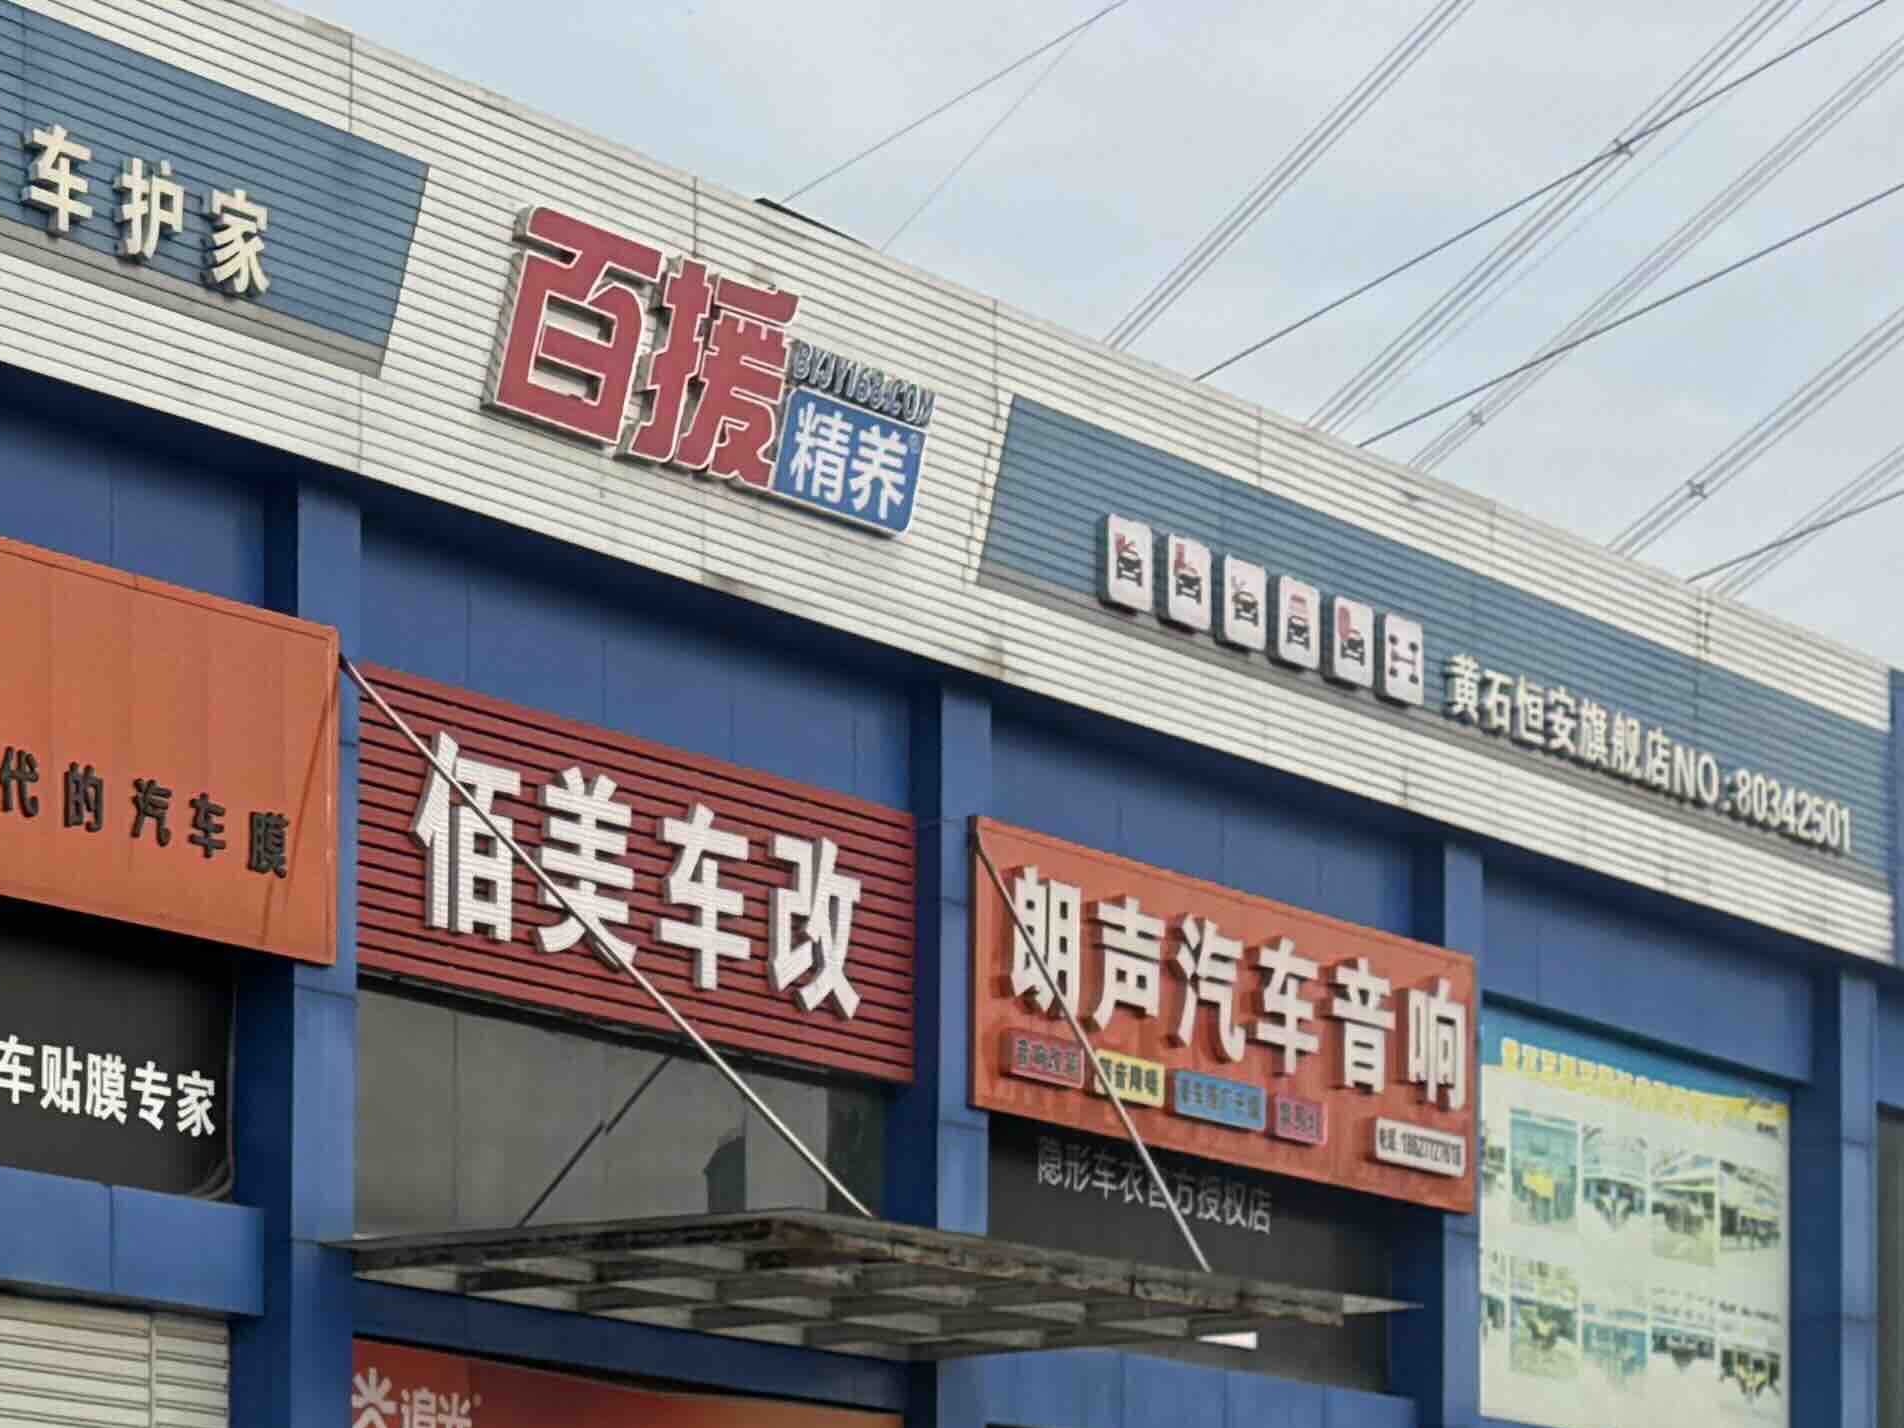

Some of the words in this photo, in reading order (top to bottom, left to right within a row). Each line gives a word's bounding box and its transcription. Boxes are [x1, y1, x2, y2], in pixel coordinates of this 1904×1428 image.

[789, 400, 910, 520] 精养
[411, 730, 862, 1019] 佰美车改
[1011, 864, 1468, 1112] 朗声汽车音响
